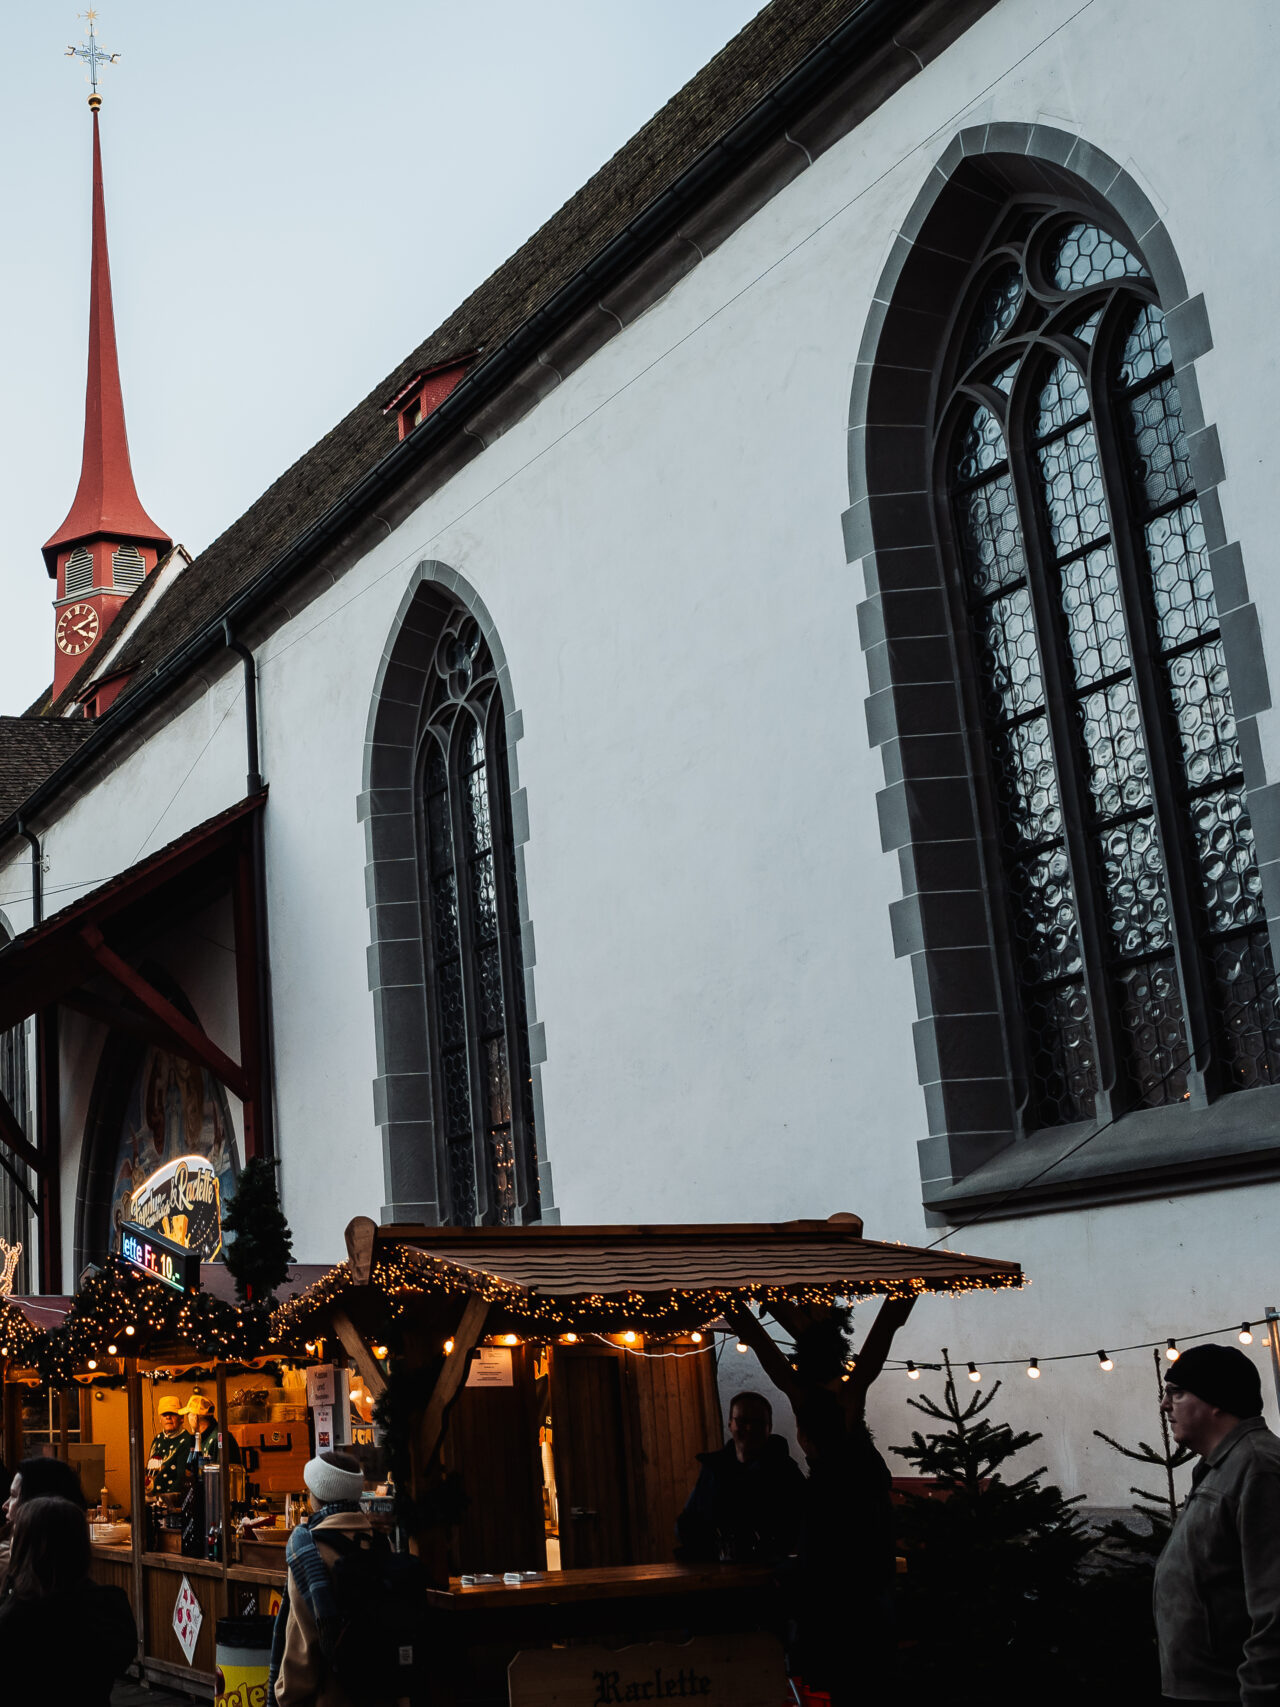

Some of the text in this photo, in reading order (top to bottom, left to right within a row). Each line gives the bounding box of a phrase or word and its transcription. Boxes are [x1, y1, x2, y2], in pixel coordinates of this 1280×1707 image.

[175, 1161, 214, 1211] Raclette
[123, 1232, 142, 1261] lette
[144, 1243, 159, 1272] Fr.
[592, 1667, 713, 1707] Raclette
